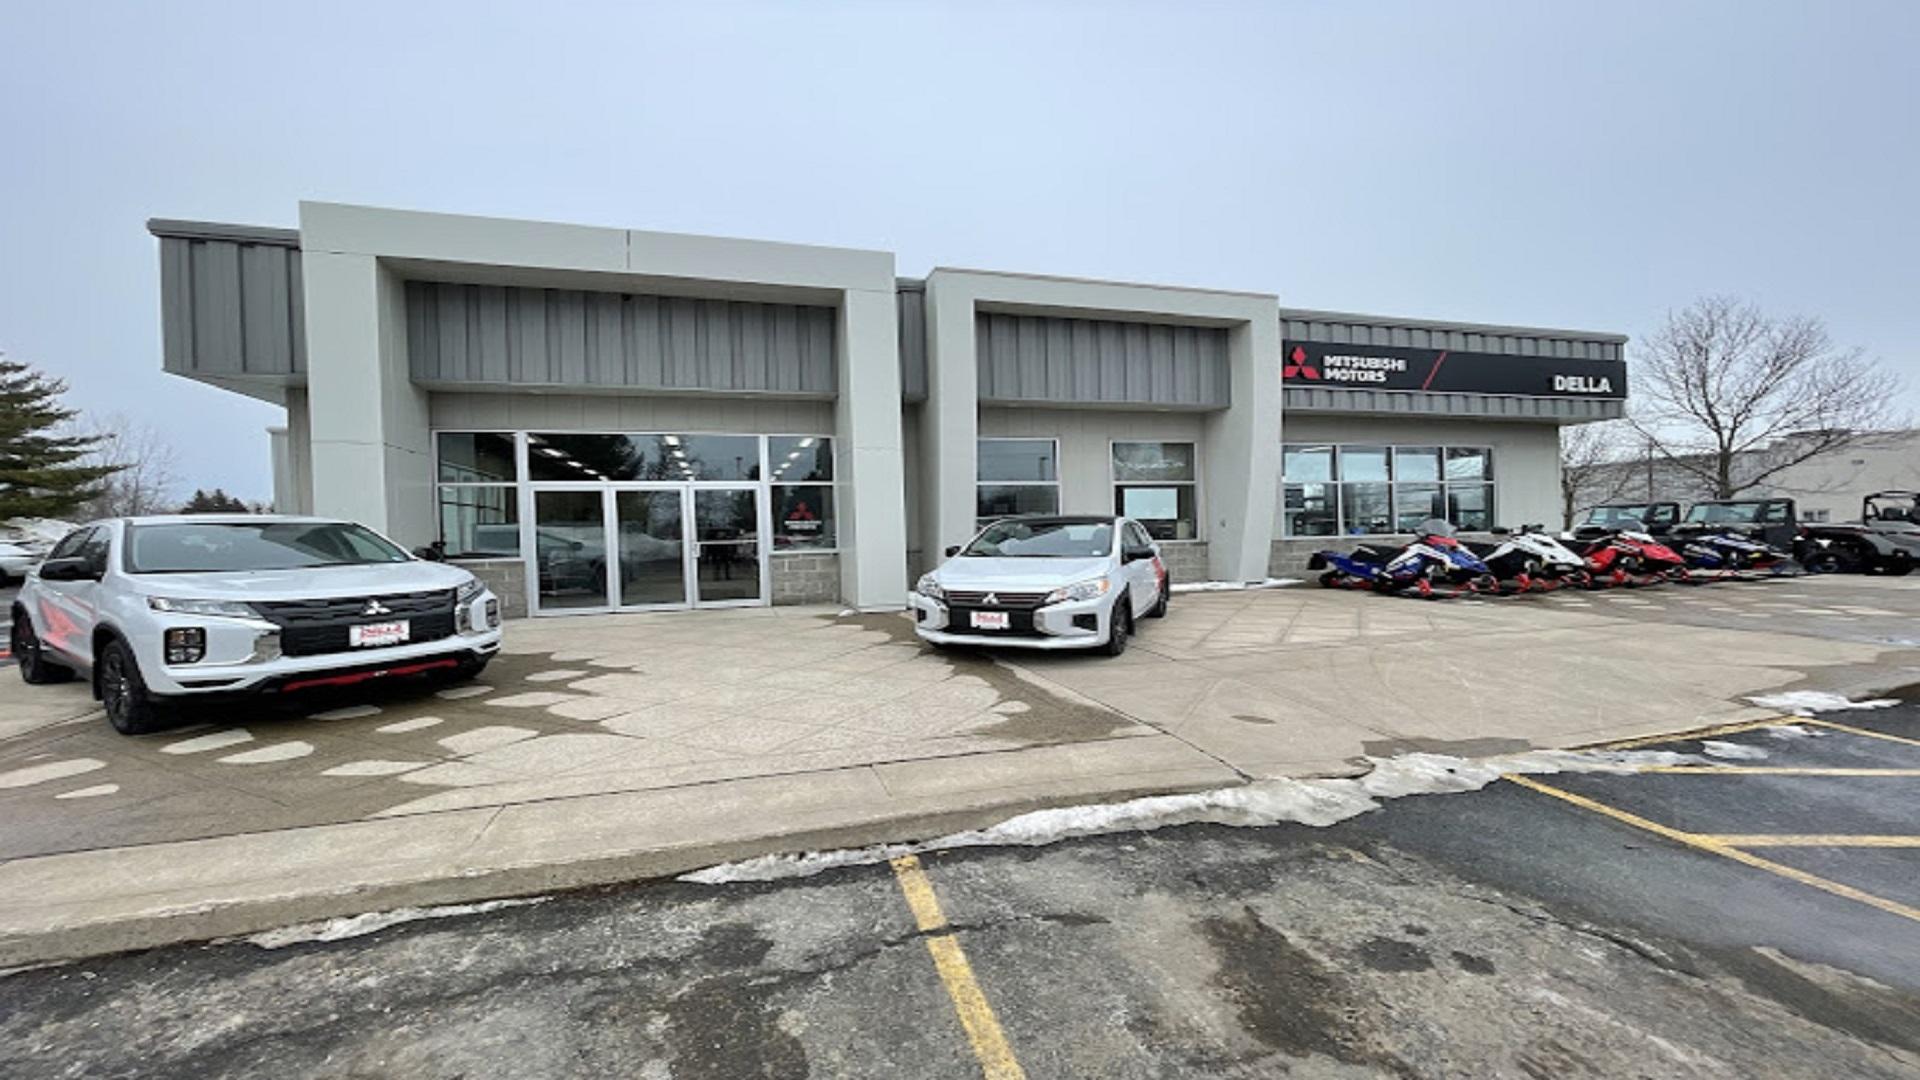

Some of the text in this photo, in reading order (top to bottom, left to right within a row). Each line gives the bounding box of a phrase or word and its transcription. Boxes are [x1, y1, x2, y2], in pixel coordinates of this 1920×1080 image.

[1323, 355, 1407, 371] MITSUBISHI
[1323, 367, 1387, 382] MOTORS
[1554, 374, 1613, 393] DELLA
